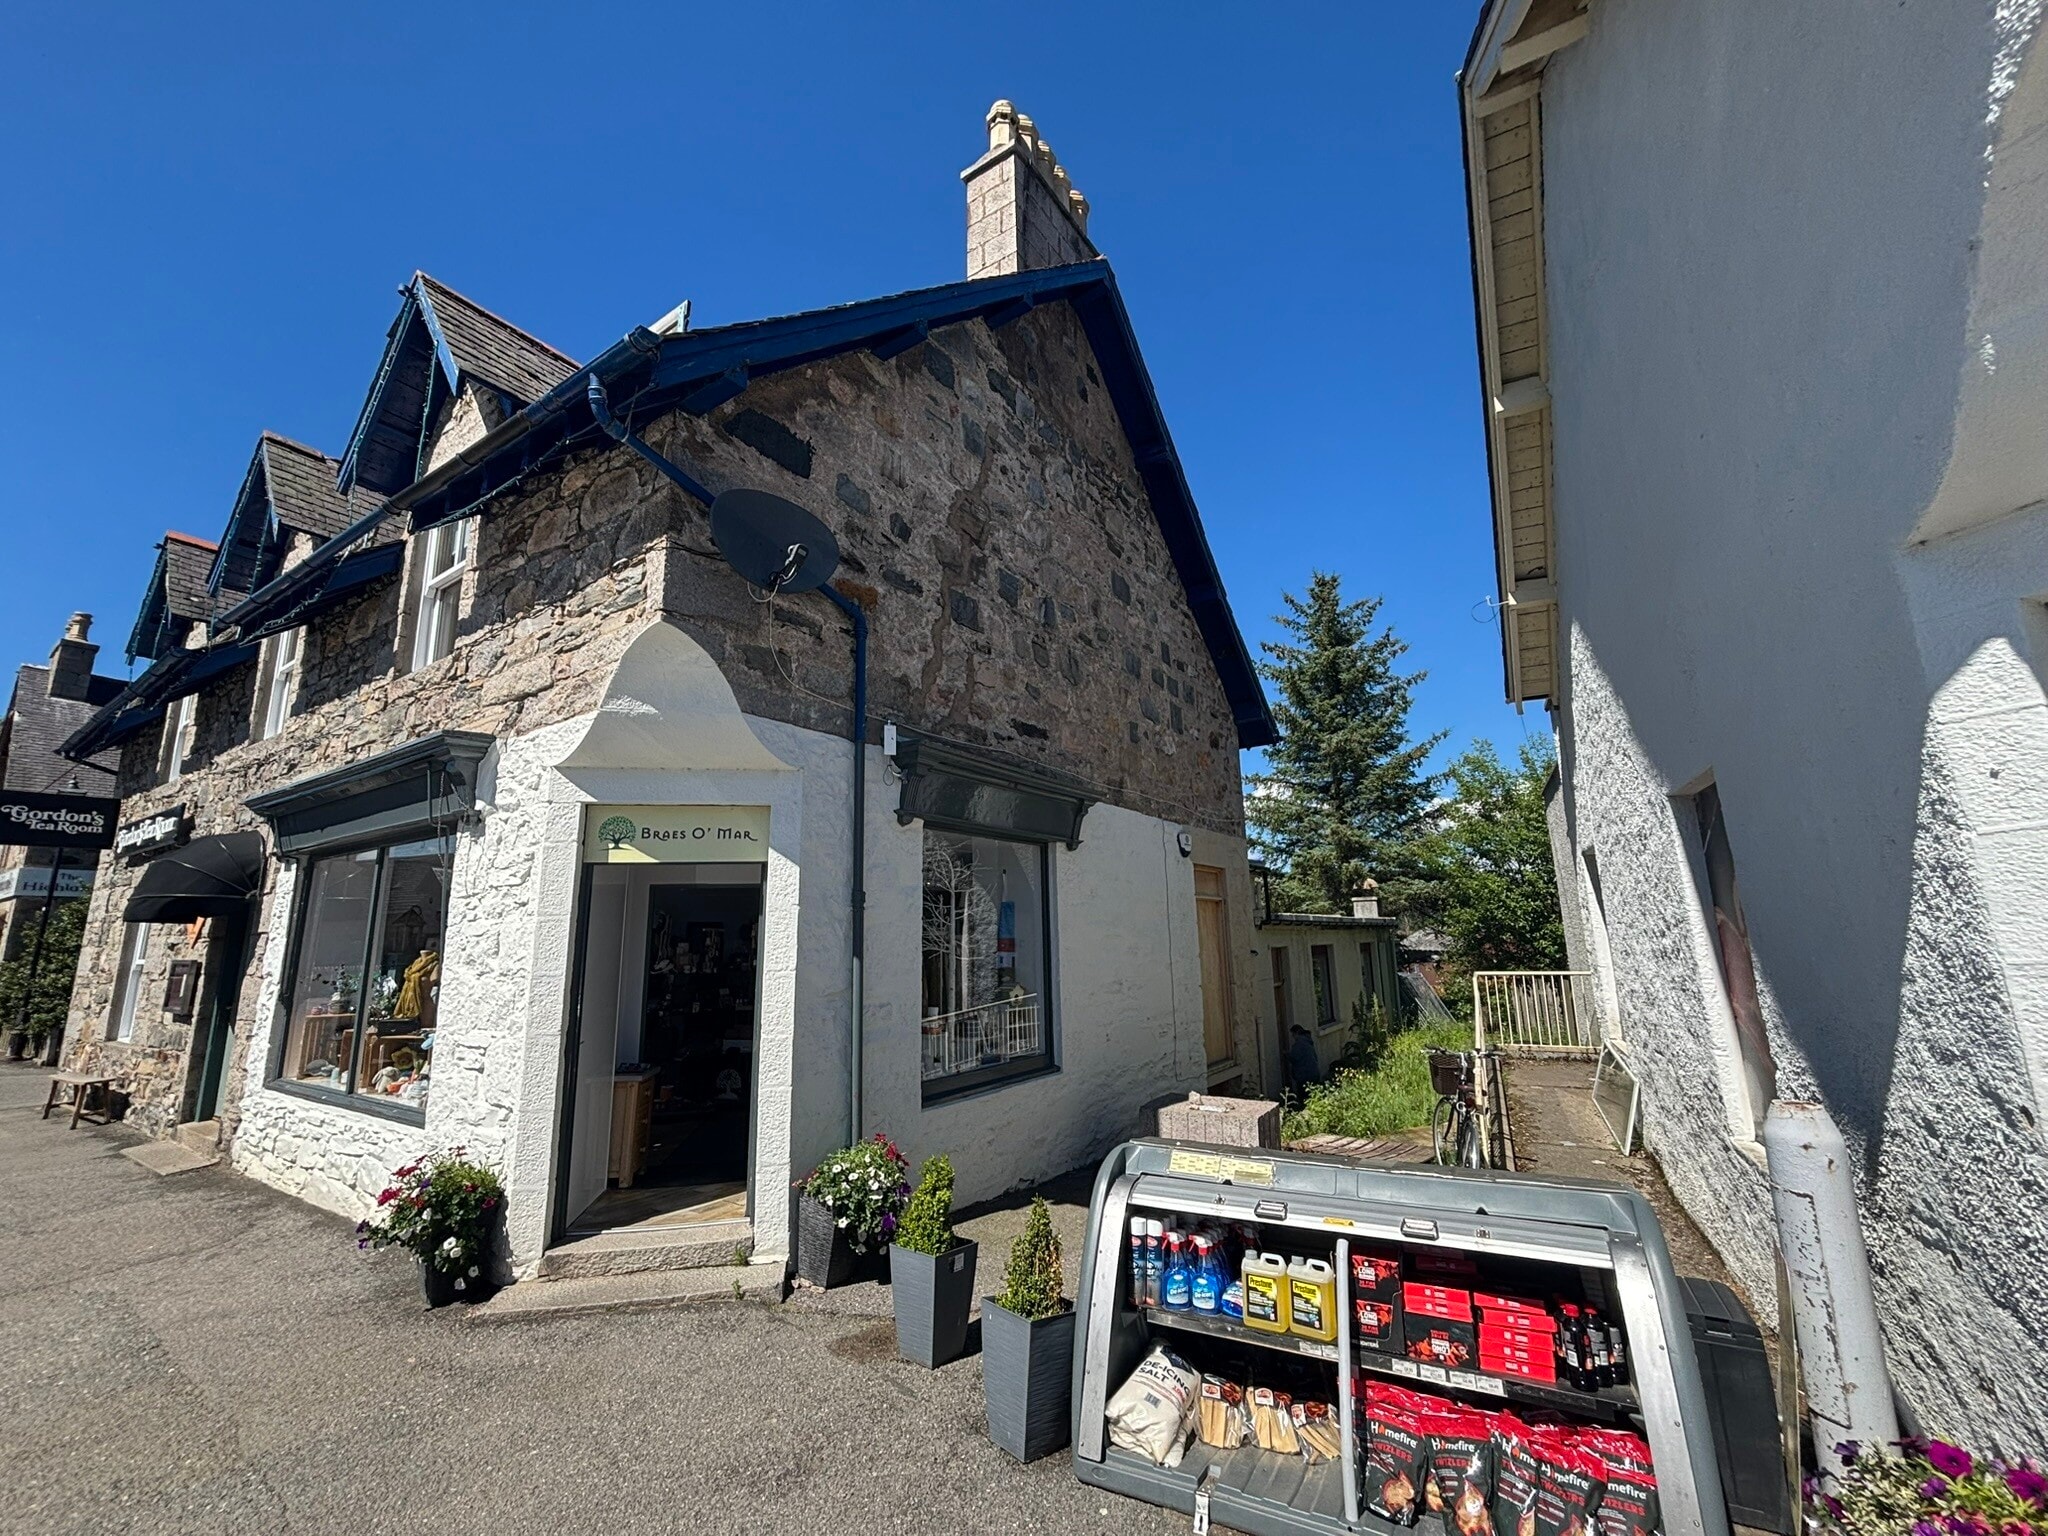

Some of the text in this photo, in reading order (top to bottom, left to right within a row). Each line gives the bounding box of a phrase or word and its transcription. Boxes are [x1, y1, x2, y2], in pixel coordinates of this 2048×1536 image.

[1, 804, 104, 826] Gordon's
[25, 818, 103, 834] Tea Room
[1249, 1276, 1273, 1289] Prestone
[1294, 1282, 1317, 1296] Prestone
[1139, 1366, 1169, 1382] SALT
[1370, 1420, 1417, 1448] Homefire
[1608, 1482, 1647, 1500] mefire
